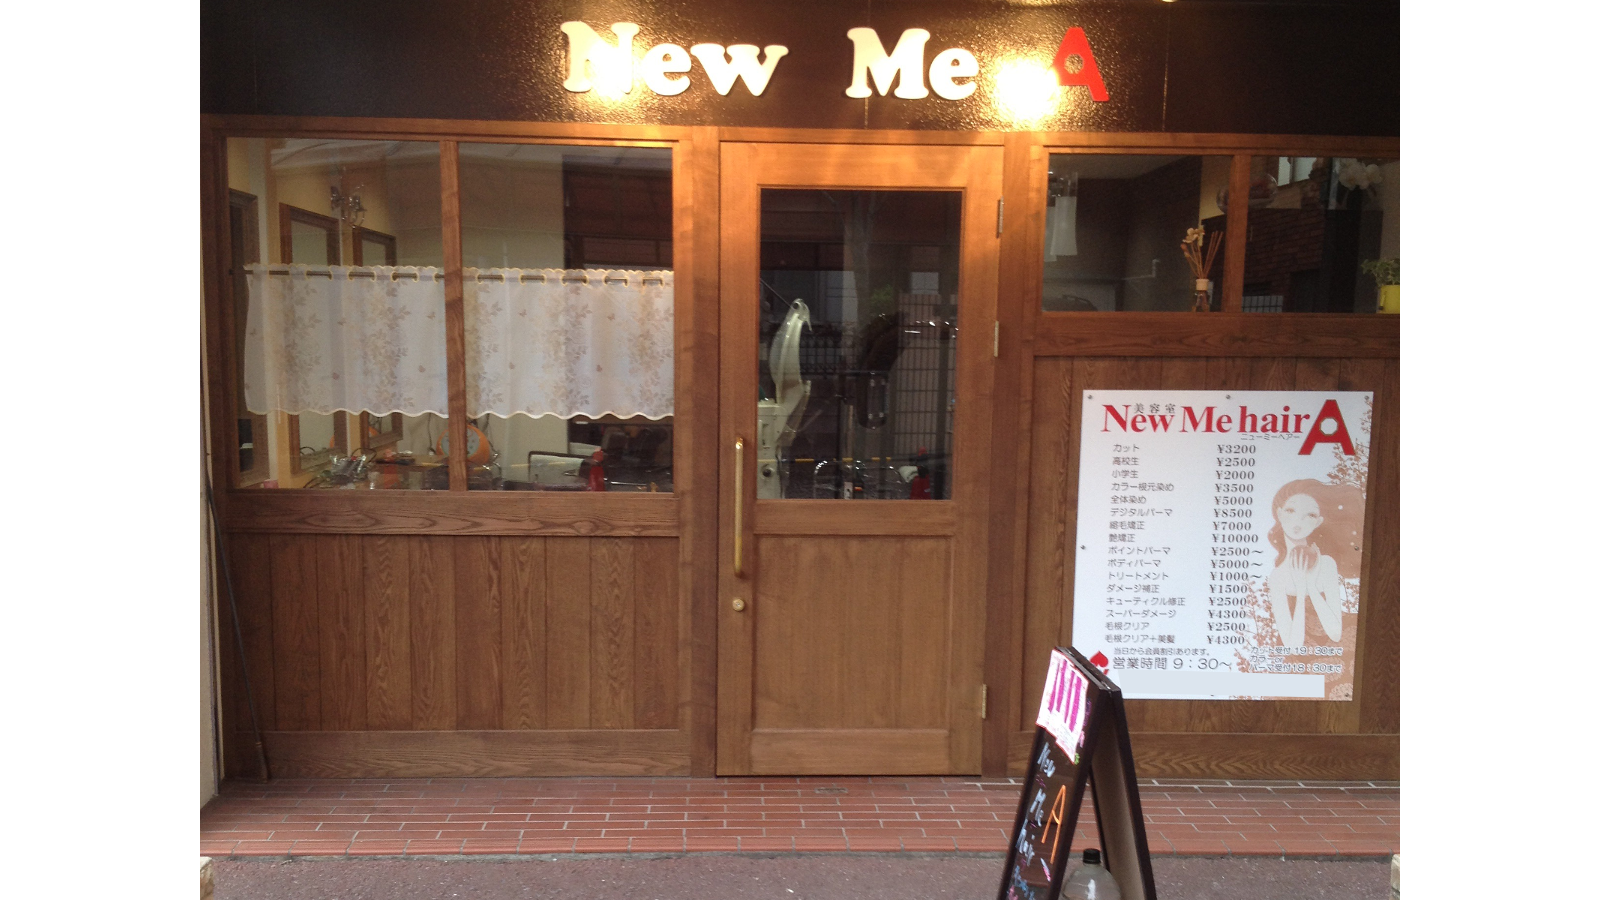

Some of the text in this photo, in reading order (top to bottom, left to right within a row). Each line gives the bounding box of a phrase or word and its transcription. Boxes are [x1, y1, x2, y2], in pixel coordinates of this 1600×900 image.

[560, 21, 1109, 101] New Me A
[1134, 402, 1176, 414] 美容室
[1100, 398, 1356, 456] New Me hair A
[1113, 444, 1257, 454] カット ¥3200
[1112, 456, 1256, 467] 高校生 ¥2500
[1111, 469, 1255, 480] 小学生 ¥2000
[1215, 483, 1254, 493] ¥3500
[1214, 496, 1253, 506] ¥5000
[1213, 508, 1253, 518] ¥8500
[1212, 521, 1252, 531] ¥7000
[1212, 533, 1259, 543] ¥10000
[1107, 571, 1169, 581] トリートメント
[1209, 584, 1248, 594] ¥1500
[1208, 596, 1247, 606] ¥2500
[1208, 609, 1247, 619] ¥4300
[1207, 622, 1246, 632] ¥2500
[1206, 635, 1245, 645] ¥4300
[1112, 657, 1168, 670] 営業時間
[1041, 784, 1066, 864] A
